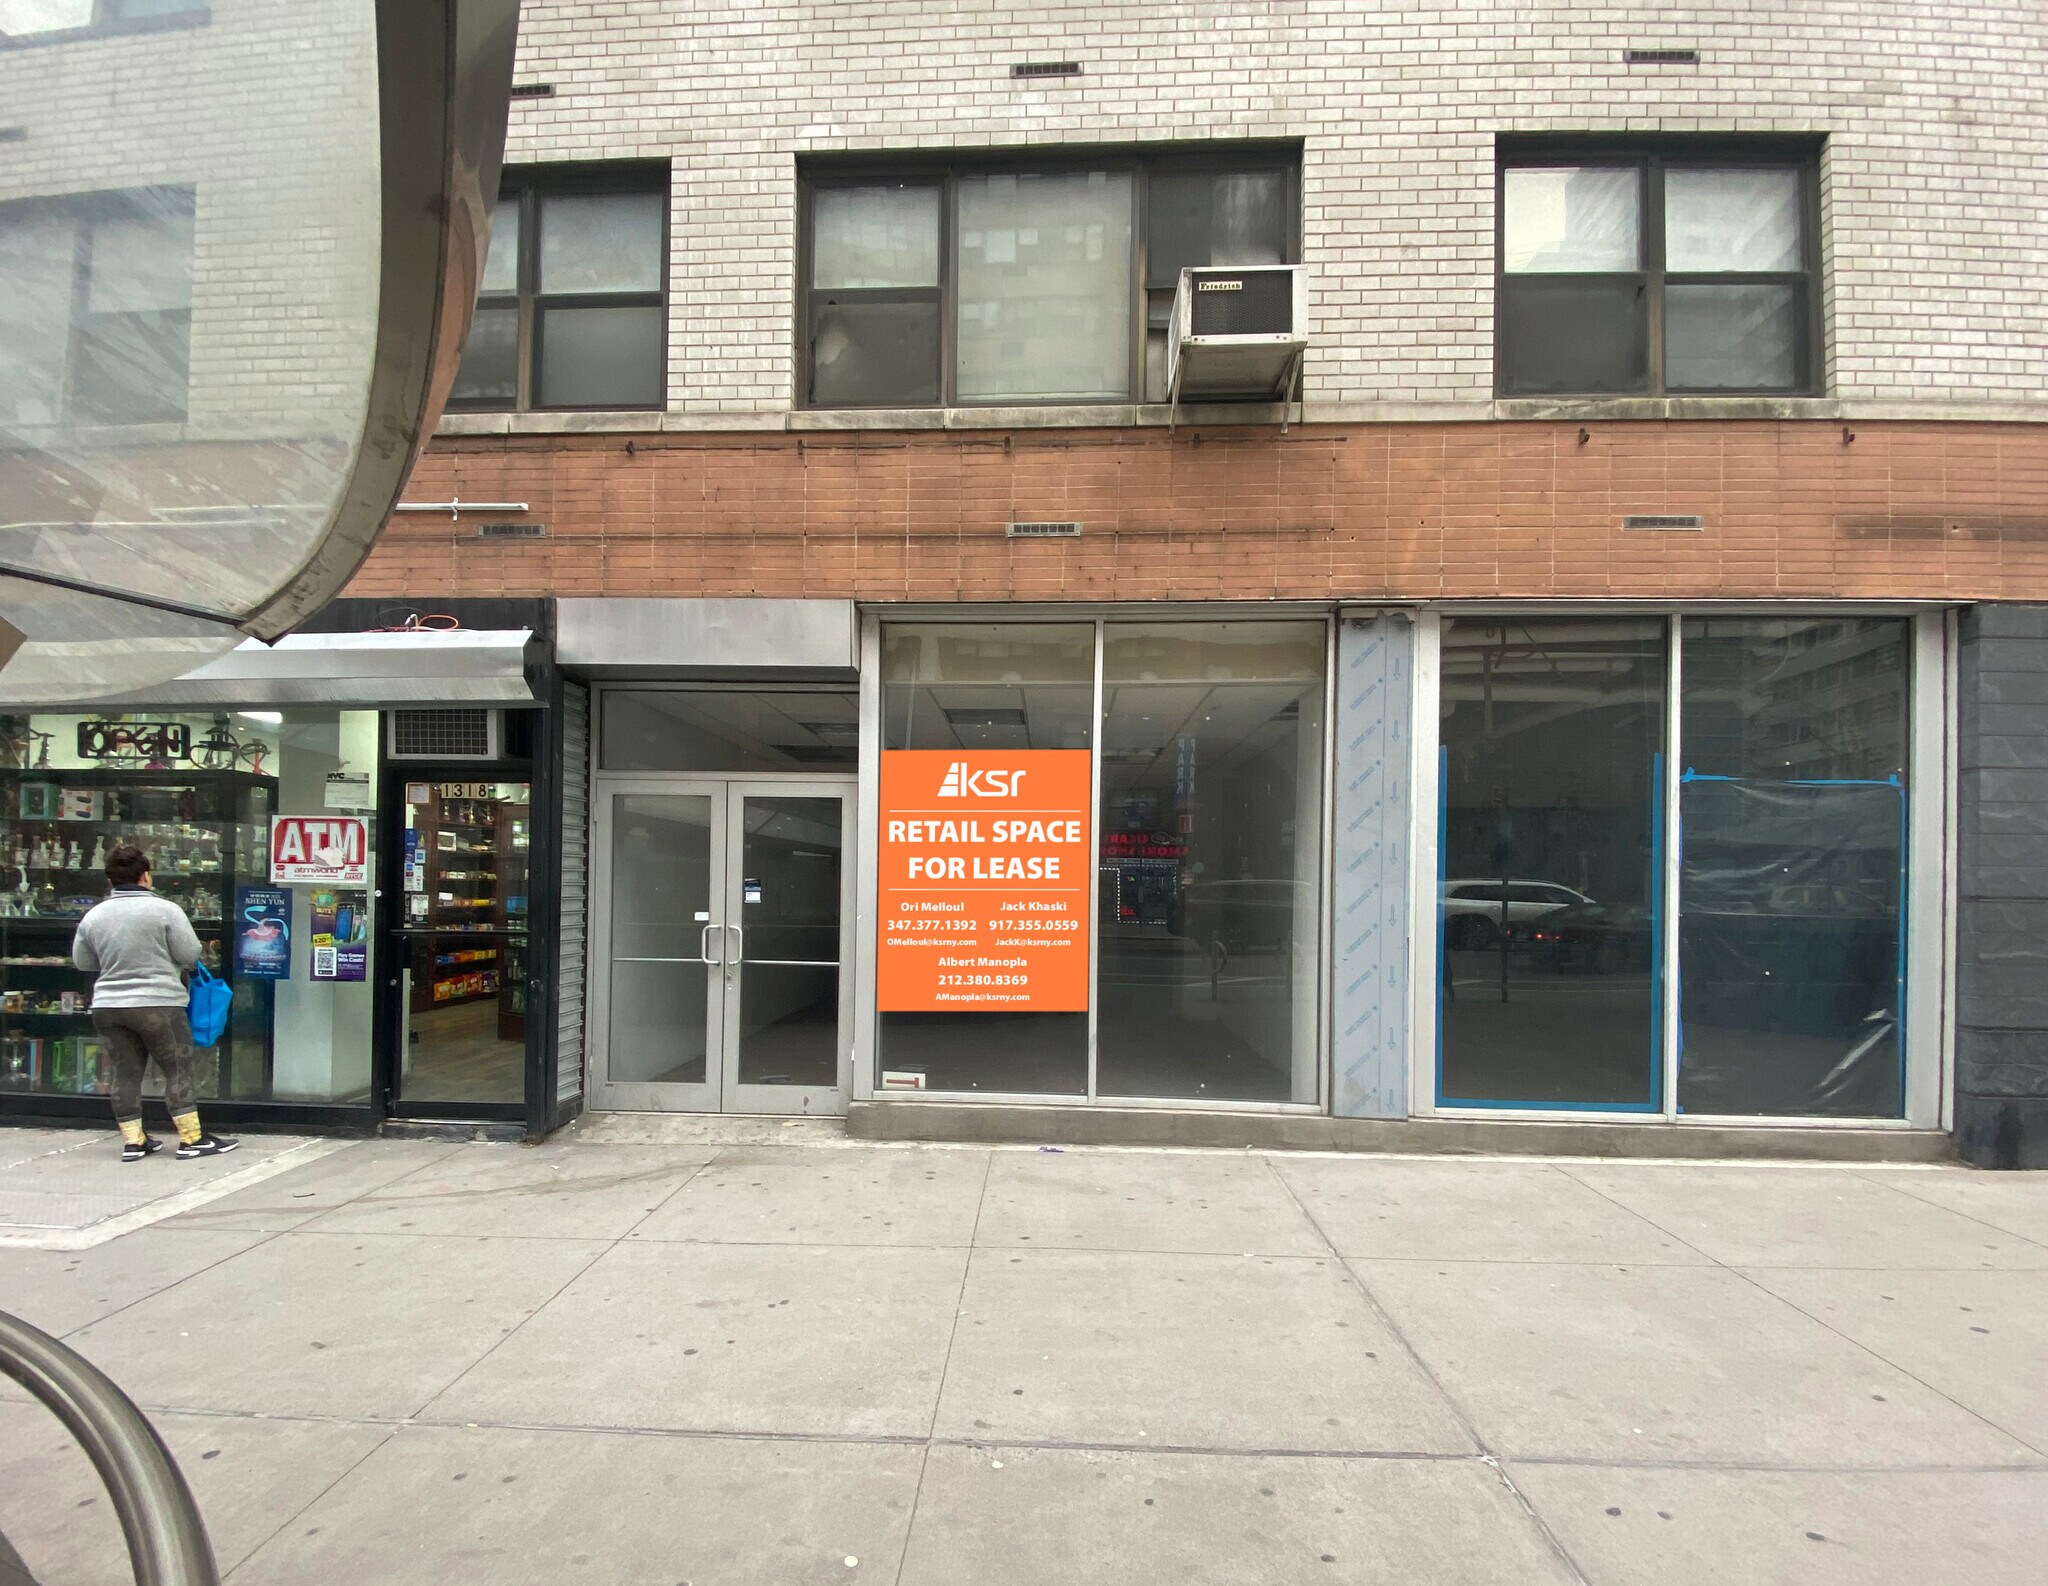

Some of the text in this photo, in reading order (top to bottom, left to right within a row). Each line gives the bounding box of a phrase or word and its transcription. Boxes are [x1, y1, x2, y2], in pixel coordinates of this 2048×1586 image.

[1200, 281, 1242, 290] Friedrich
[86, 725, 182, 755] OPEN
[444, 784, 487, 798] 1318
[888, 820, 1081, 843] RETAIL SPACE
[278, 821, 358, 863] ATM
[908, 856, 1060, 880] FOR LEASE
[245, 897, 267, 905] SHEN
[900, 901, 965, 912] Ori Melloul
[1000, 901, 1067, 912] Jack Khaski
[887, 919, 977, 931] 347.377.1392
[988, 919, 1079, 931] 917.355.0559
[886, 937, 977, 948] OMelloul@ksrny.com
[995, 938, 1071, 948] JackK@ksrny.com
[938, 956, 1028, 969] Albert Manopla
[937, 974, 1029, 986] 212.380.8369
[935, 991, 1031, 1004] AManopla@ksrny.com
